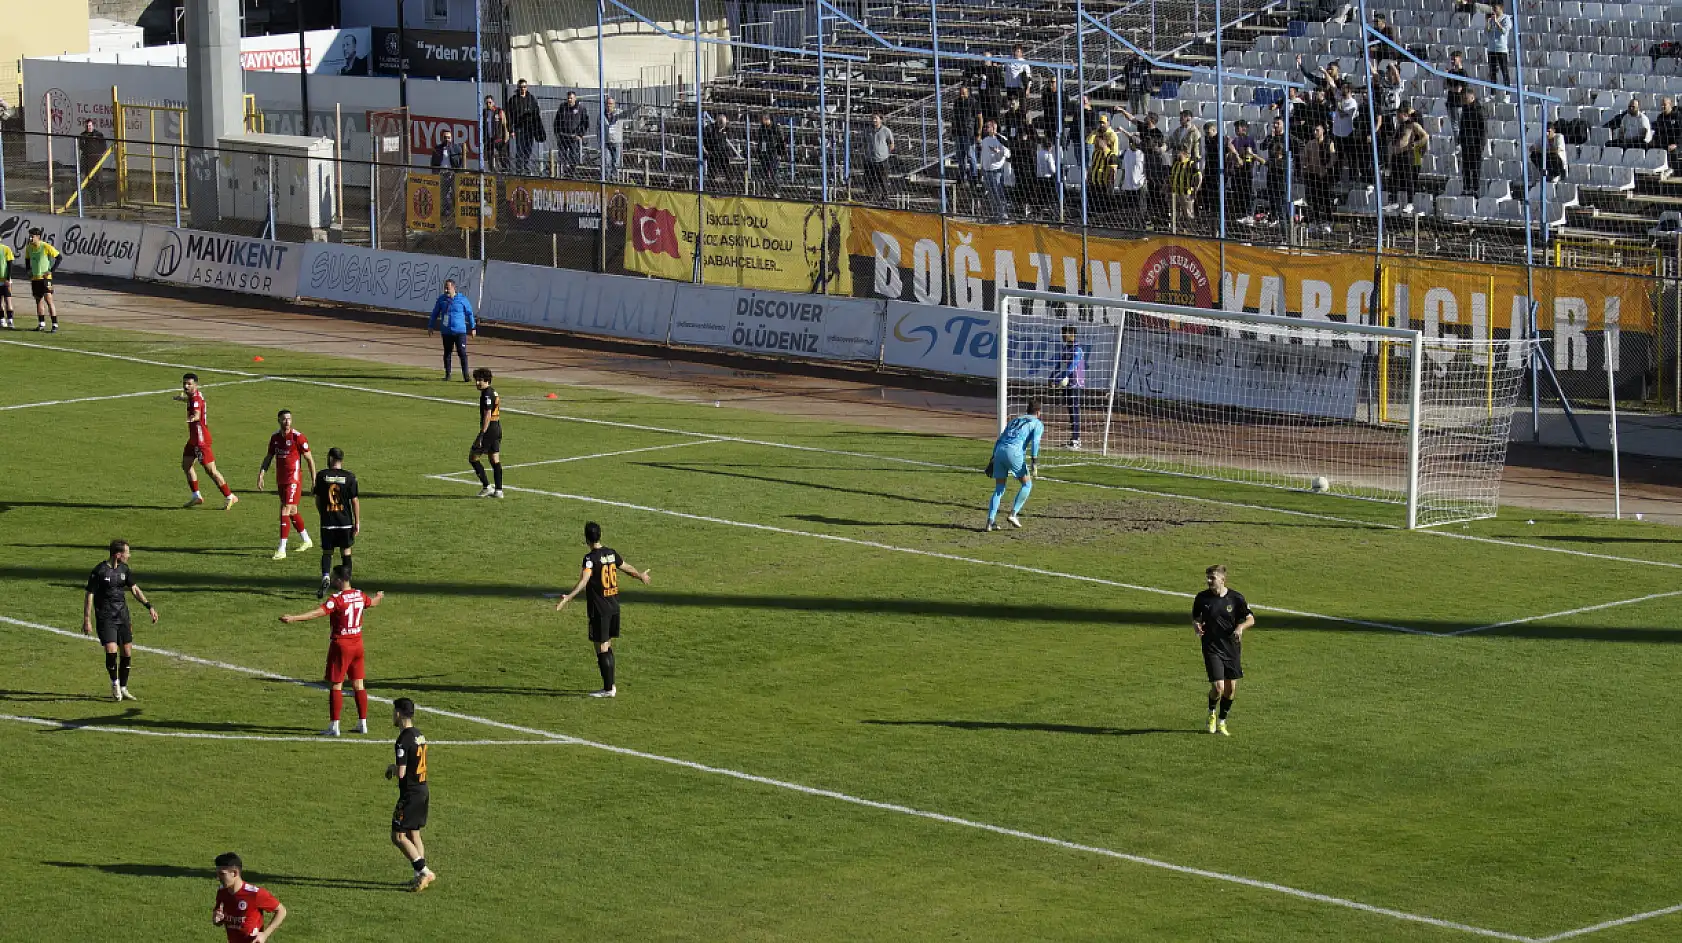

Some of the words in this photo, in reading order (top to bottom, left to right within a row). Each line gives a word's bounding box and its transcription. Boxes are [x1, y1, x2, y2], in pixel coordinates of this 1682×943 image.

[191, 268, 273, 292] ASANSÖR
[310, 251, 391, 296] SUGAR
[871, 231, 1124, 326] BOĞAZIN
[1145, 258, 1169, 286] SPOR
[732, 321, 819, 353] ÖLÜDENİZ
[601, 563, 617, 588] 66
[344, 602, 364, 628] 17
